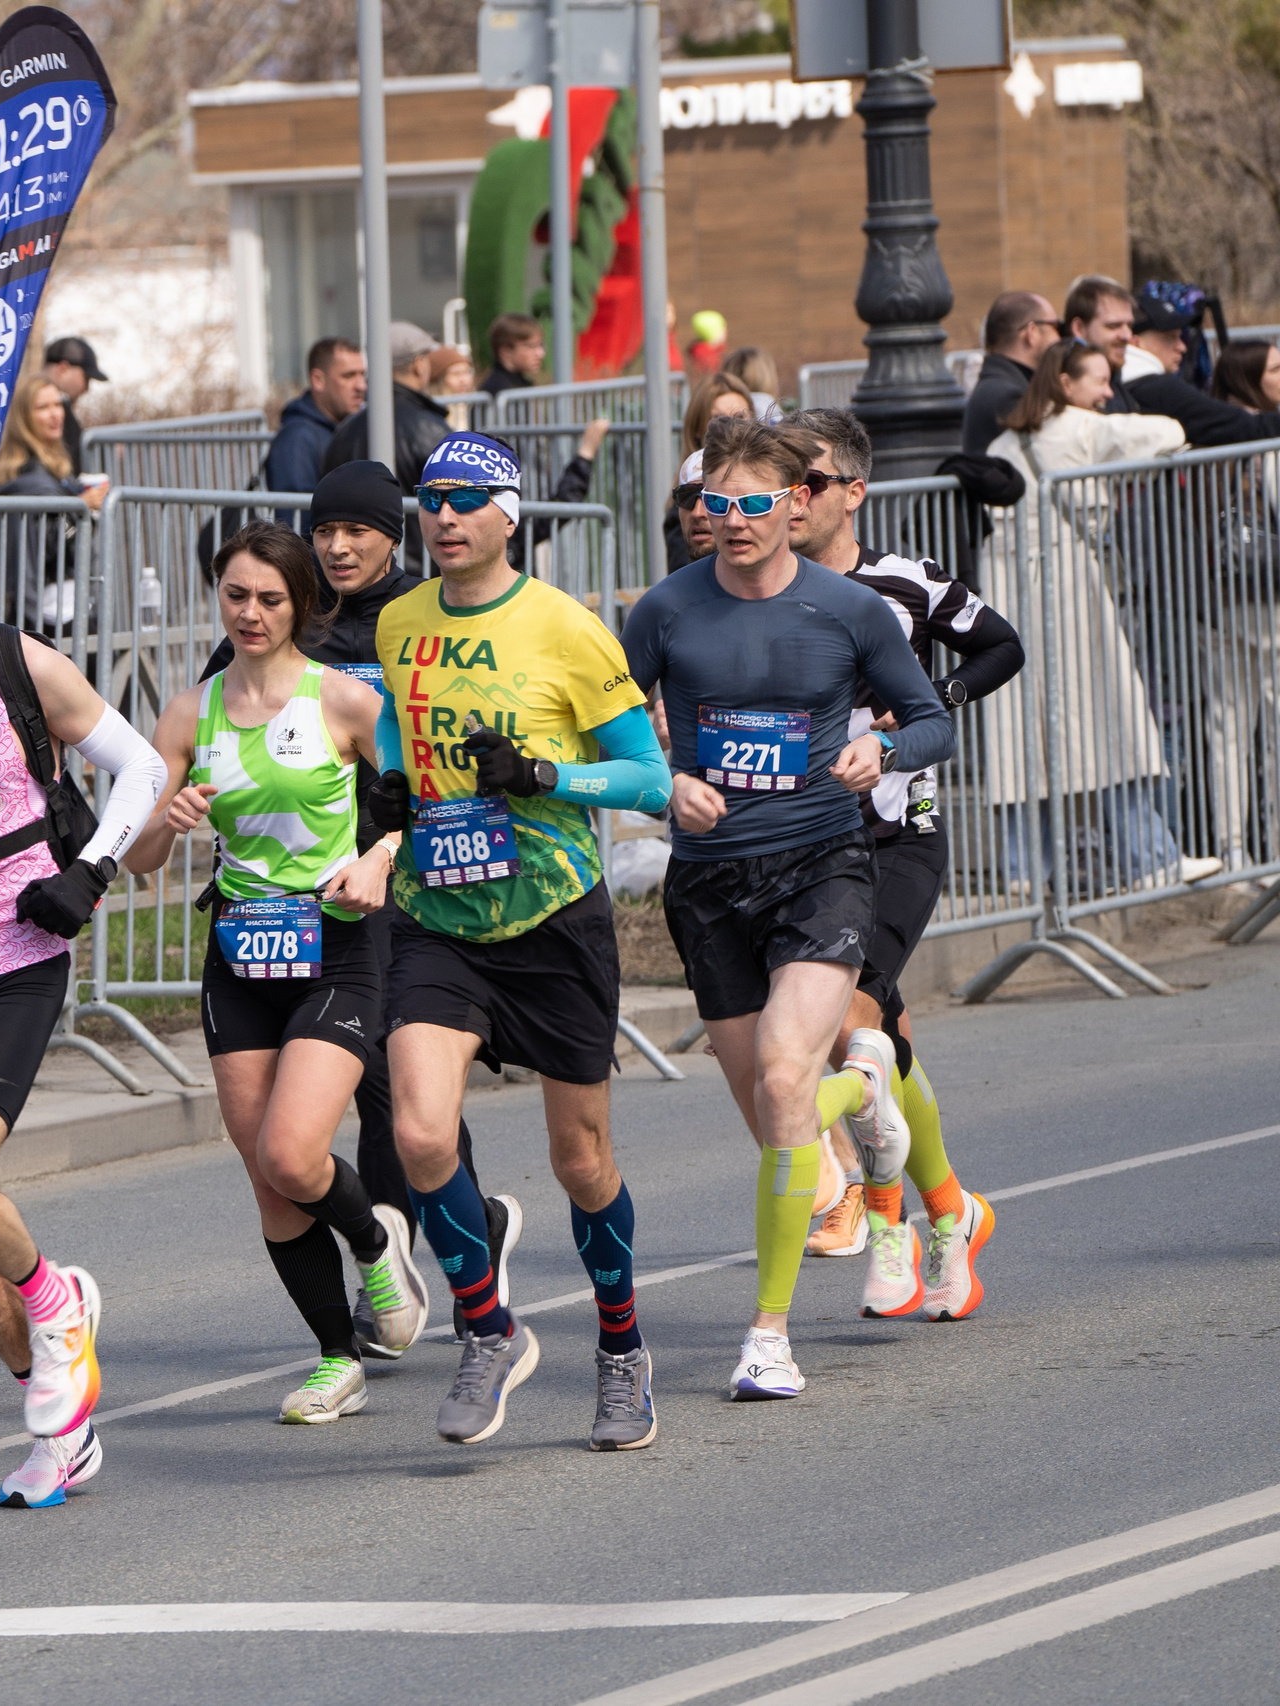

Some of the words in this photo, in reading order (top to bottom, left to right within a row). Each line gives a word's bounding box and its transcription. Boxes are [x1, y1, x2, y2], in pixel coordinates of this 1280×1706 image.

[0, 52, 67, 88] GARMIN
[397, 636, 498, 671] LUKA
[721, 740, 781, 772] 2271
[430, 831, 491, 867] 2188
[236, 930, 298, 960] 2078
